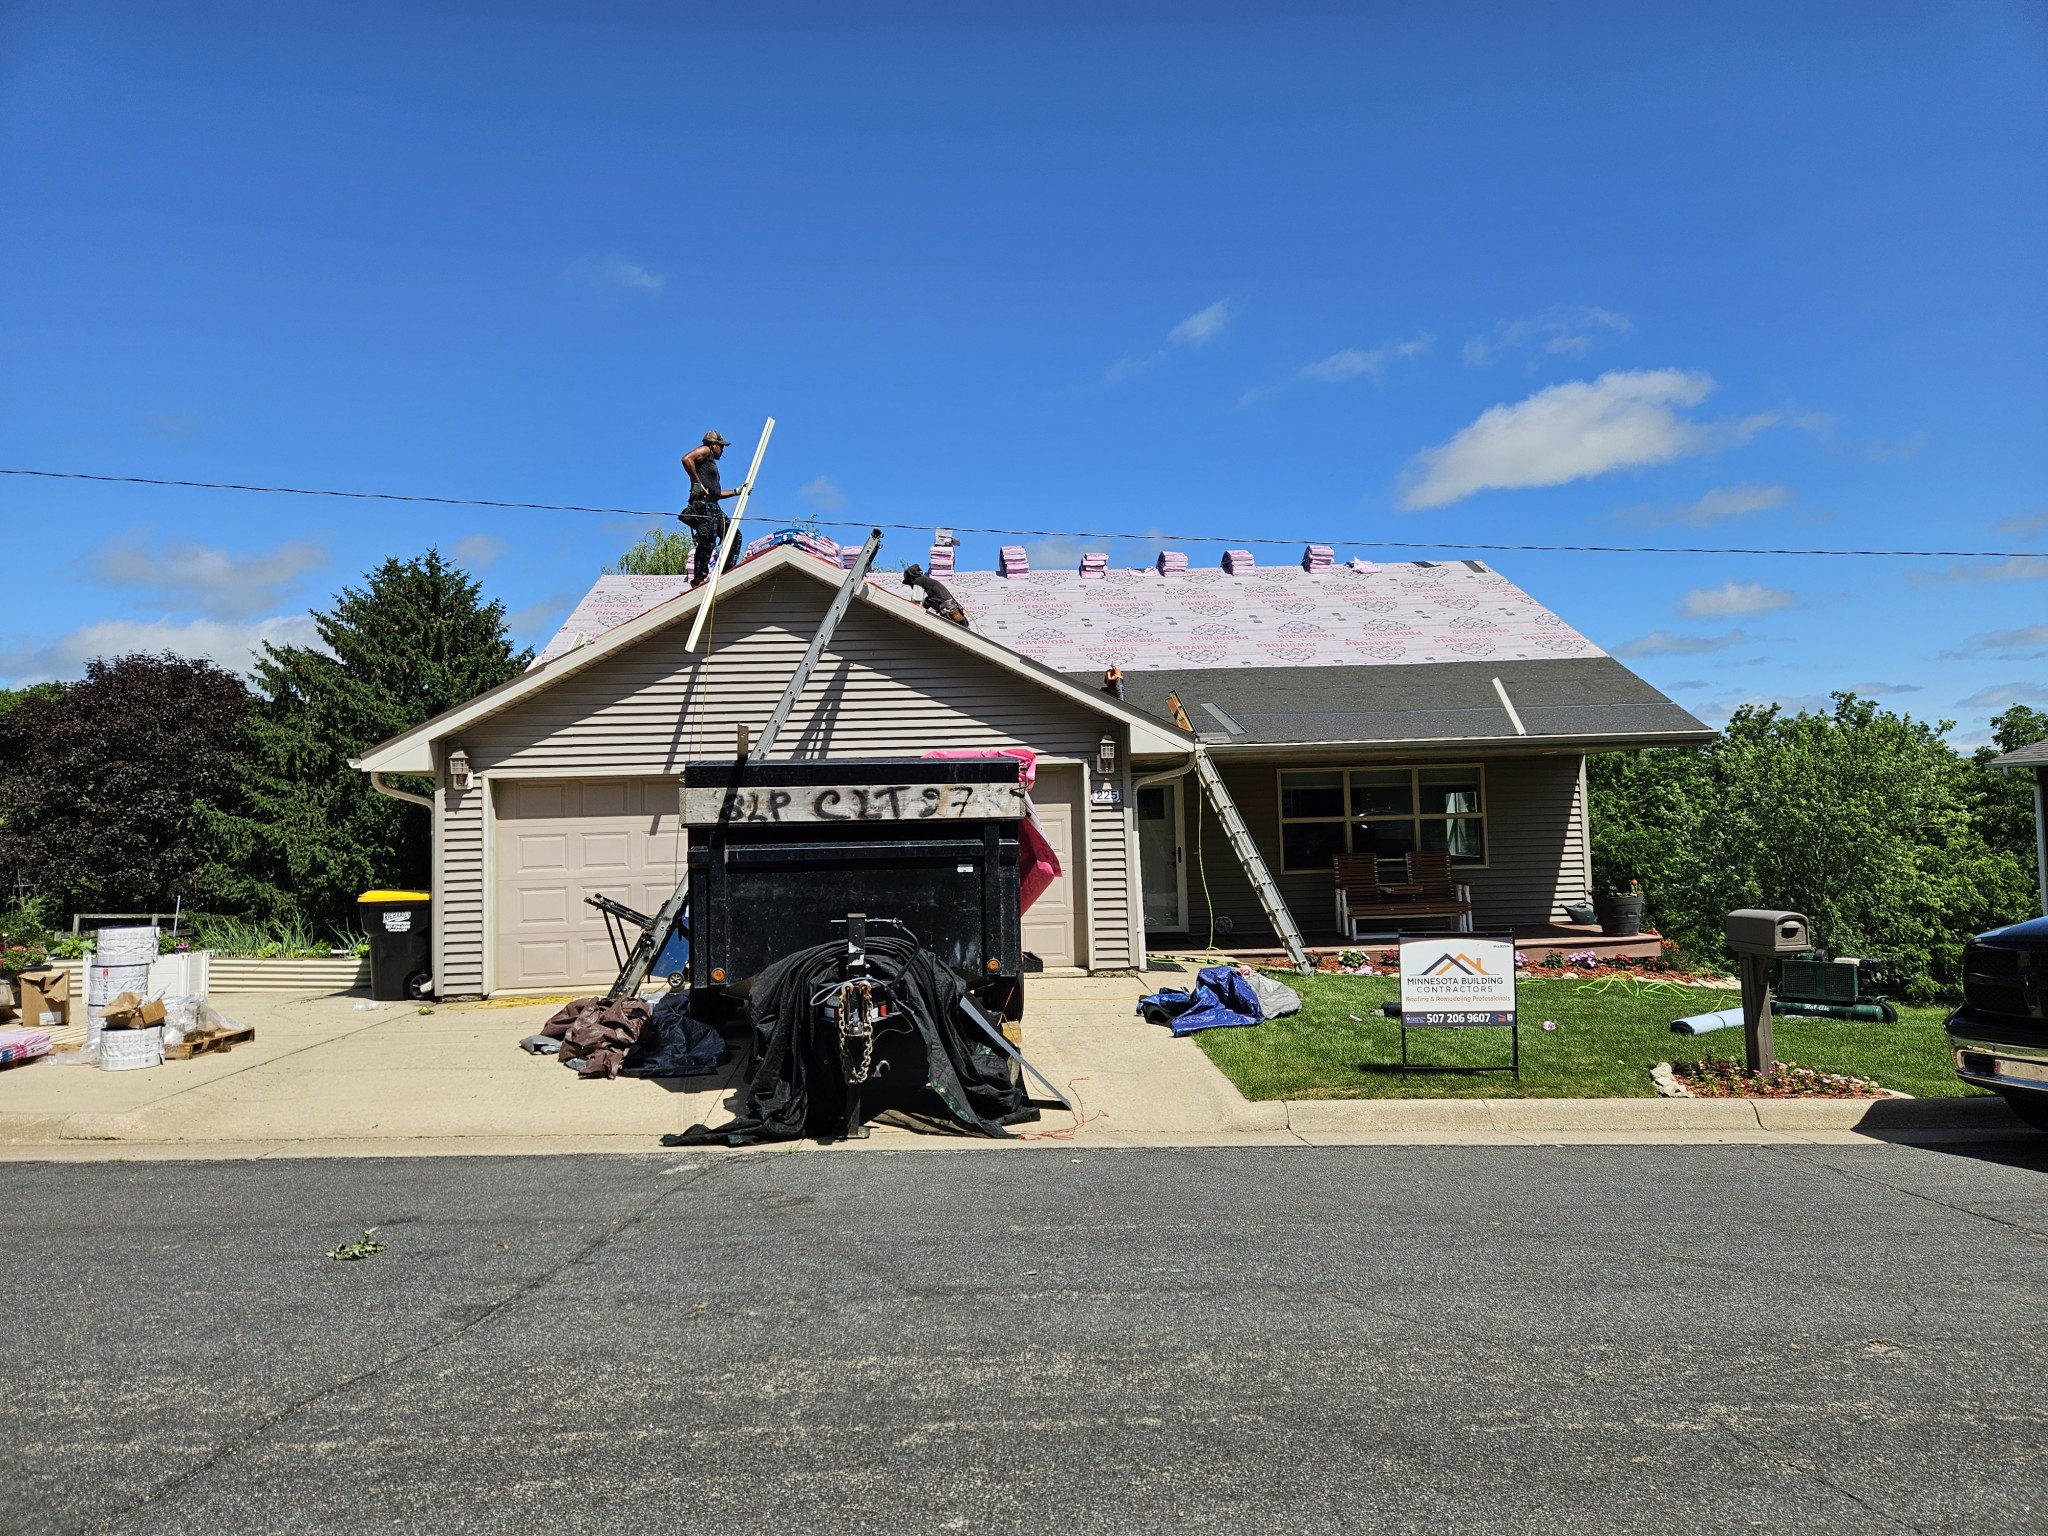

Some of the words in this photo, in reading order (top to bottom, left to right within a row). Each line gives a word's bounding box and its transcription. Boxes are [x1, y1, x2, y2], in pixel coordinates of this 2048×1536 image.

[1096, 790, 1118, 800] 225
[1407, 977, 1459, 985] MINNESOTA
[1461, 977, 1504, 985] BUILDING
[1416, 985, 1493, 993] CONTRACTORS
[1426, 1013, 1445, 1024] 507
[1446, 1013, 1465, 1023] 206
[1466, 1013, 1491, 1023] 9607
